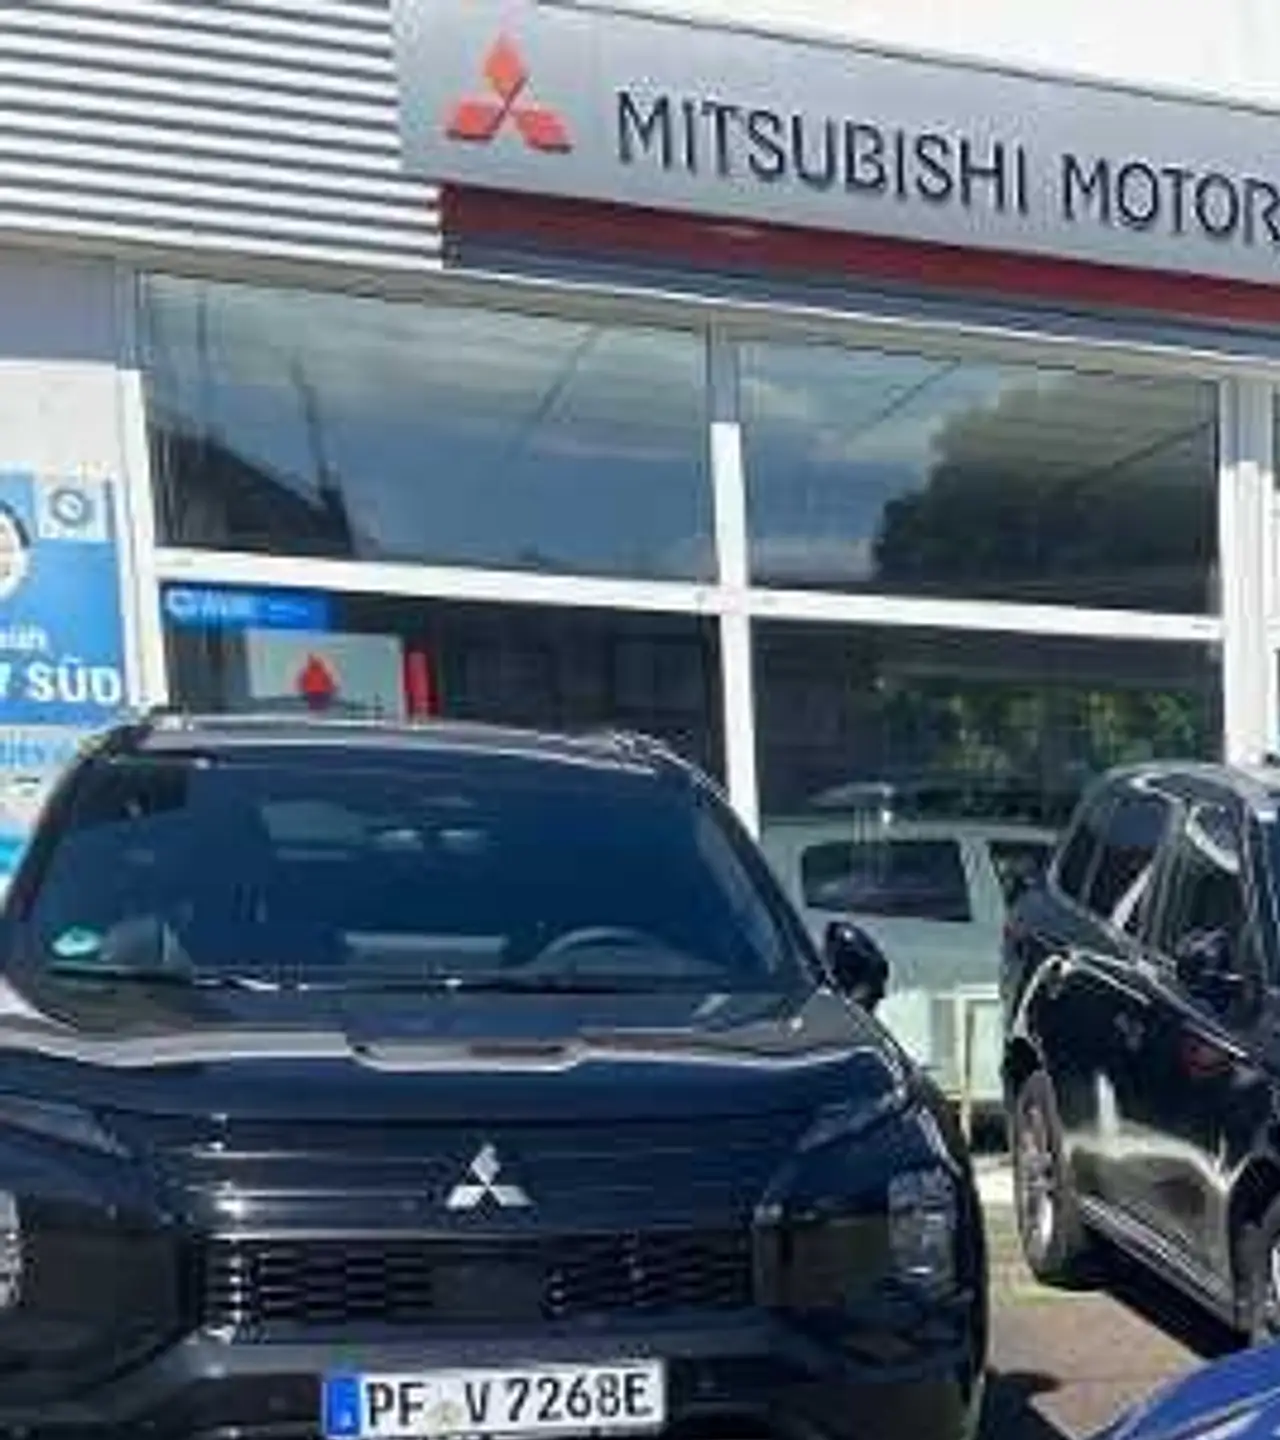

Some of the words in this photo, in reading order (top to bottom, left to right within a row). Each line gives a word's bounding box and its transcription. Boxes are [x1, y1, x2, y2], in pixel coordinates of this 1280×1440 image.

[616, 90, 1028, 217] MITSUBISHI
[26, 652, 122, 704] SÜD
[365, 1380, 427, 1428] PF
[464, 1381, 492, 1424] V
[503, 1371, 652, 1423] 7268E
